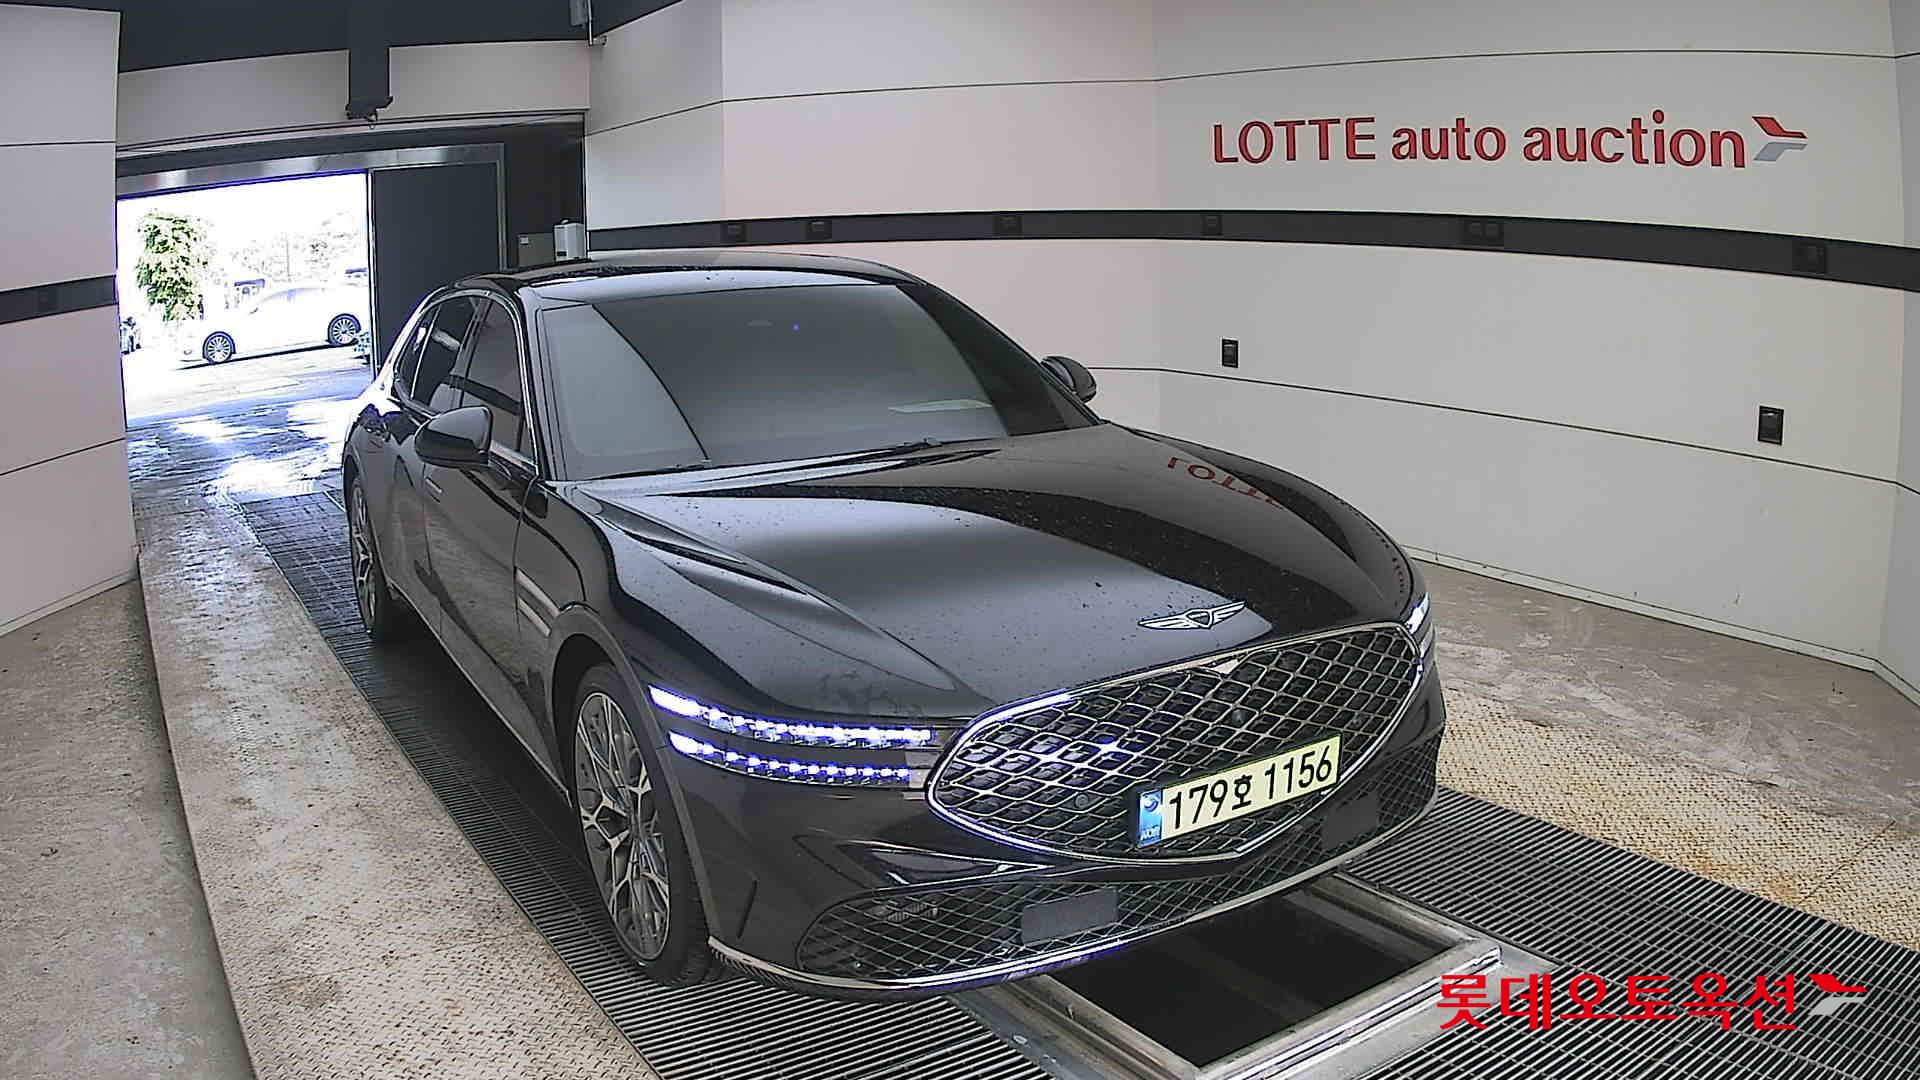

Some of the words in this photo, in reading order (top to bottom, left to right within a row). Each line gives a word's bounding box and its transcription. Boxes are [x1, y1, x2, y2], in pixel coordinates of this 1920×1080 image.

[1213, 117, 1376, 163] LOTTE
[1391, 117, 1508, 161] auto
[1523, 109, 1747, 168] auction
[1169, 774, 1253, 829] 179호
[1264, 745, 1332, 800] 1156
